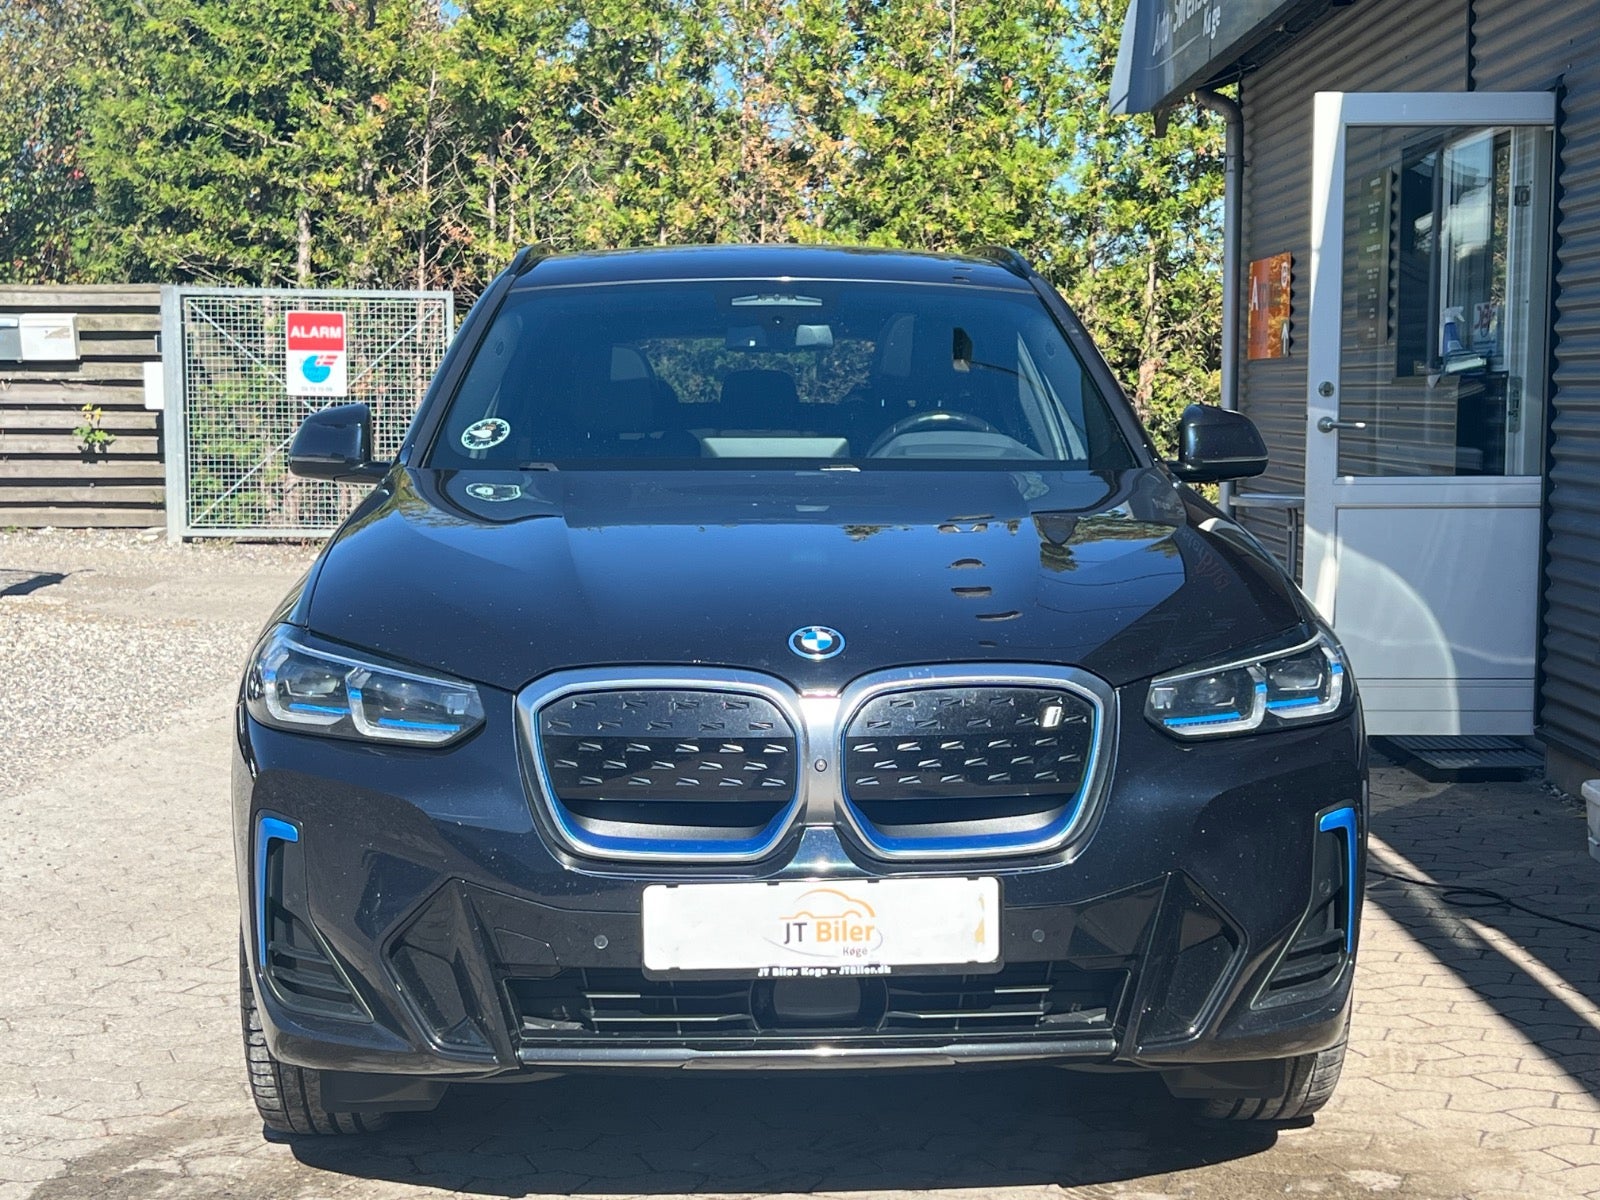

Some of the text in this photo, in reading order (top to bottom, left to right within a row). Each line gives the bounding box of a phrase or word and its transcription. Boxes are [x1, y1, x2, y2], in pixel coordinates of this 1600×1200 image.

[290, 326, 341, 338] ALARM
[784, 920, 875, 944] JT Biler
[842, 946, 868, 958] Køge
[757, 967, 770, 977] JT
[772, 967, 798, 977] Biler
[838, 964, 892, 976] JTBiler.dk
